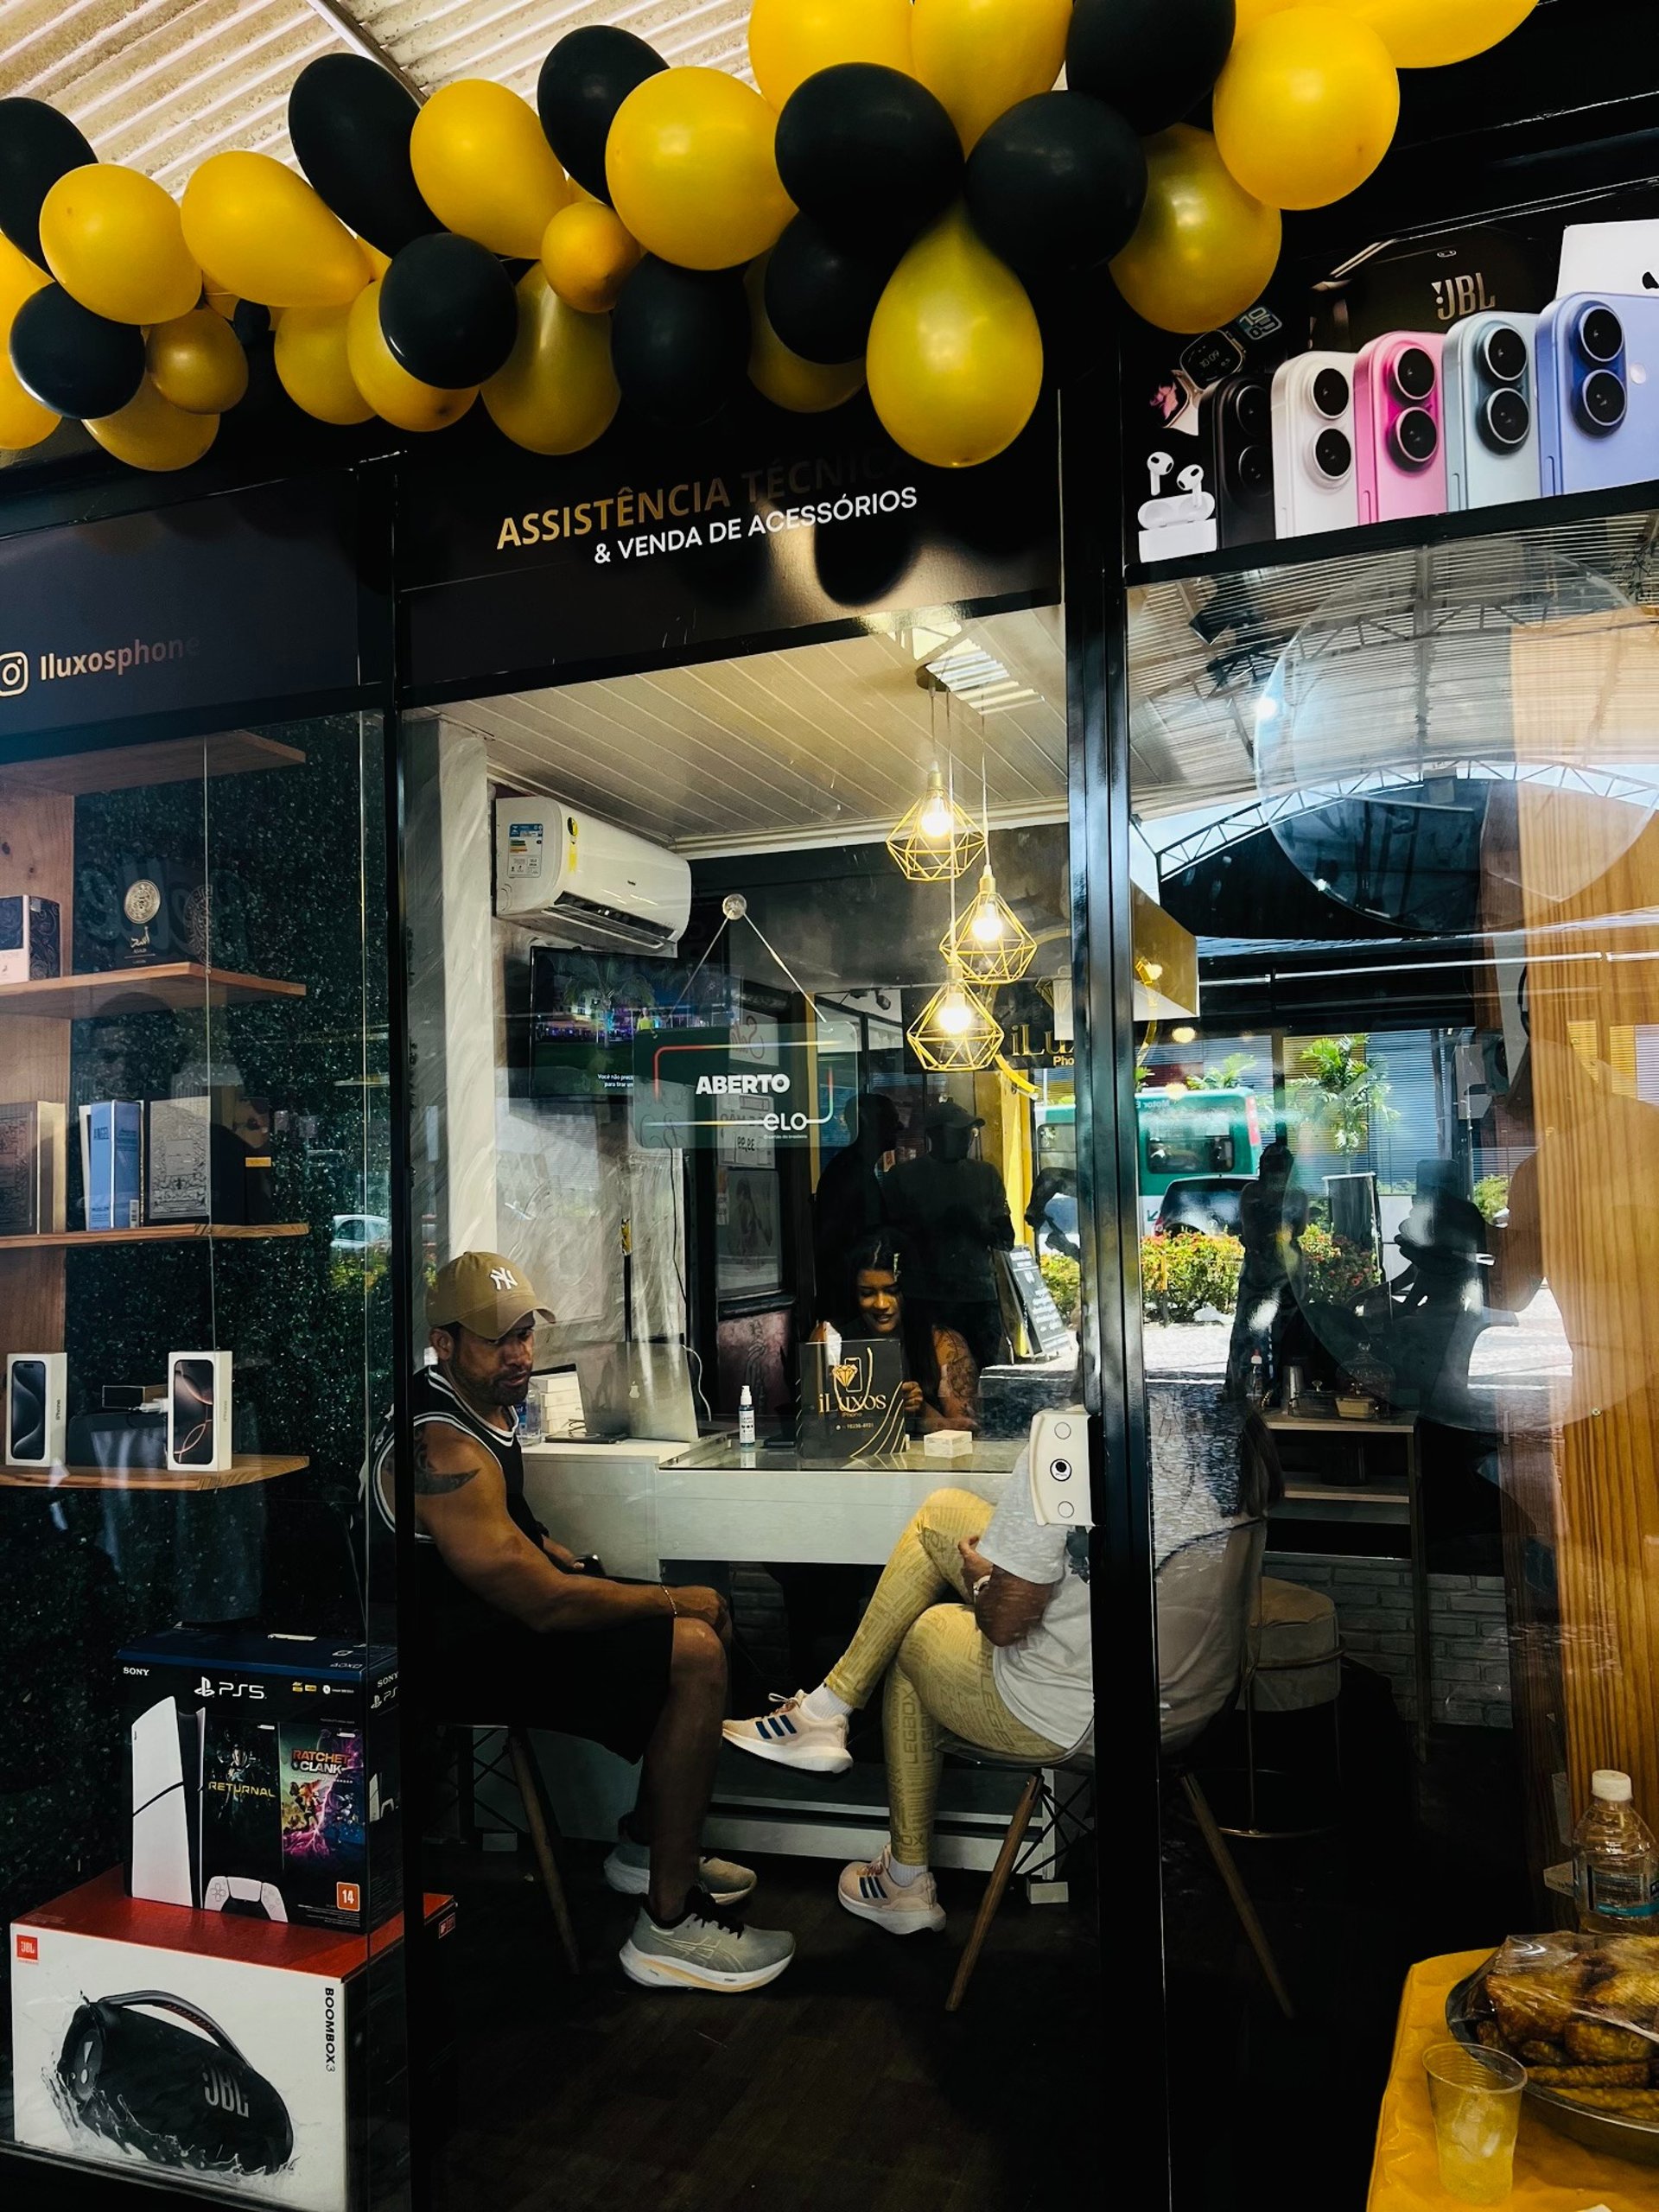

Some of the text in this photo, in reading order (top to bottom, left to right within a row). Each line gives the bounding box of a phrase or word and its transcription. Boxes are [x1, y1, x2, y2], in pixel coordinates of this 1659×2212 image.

[1431, 272, 1497, 322] JBL
[495, 475, 731, 550] ASSISTÊNCIA
[594, 486, 918, 564] & VENDA DE ACESSÓRIOS
[696, 1073, 791, 1095] ABERTO
[490, 1267, 519, 1291] NY
[123, 1667, 150, 1677] SONY
[377, 1670, 400, 1688] SONY
[219, 1681, 266, 1700] PS5
[292, 1749, 351, 1764] RATCHET
[300, 1759, 342, 1775] CLANK
[207, 1781, 276, 1798] RETURNAL
[342, 1889, 354, 1904] 14
[21, 1941, 35, 1954] JBL
[202, 2066, 250, 2119] JBL
